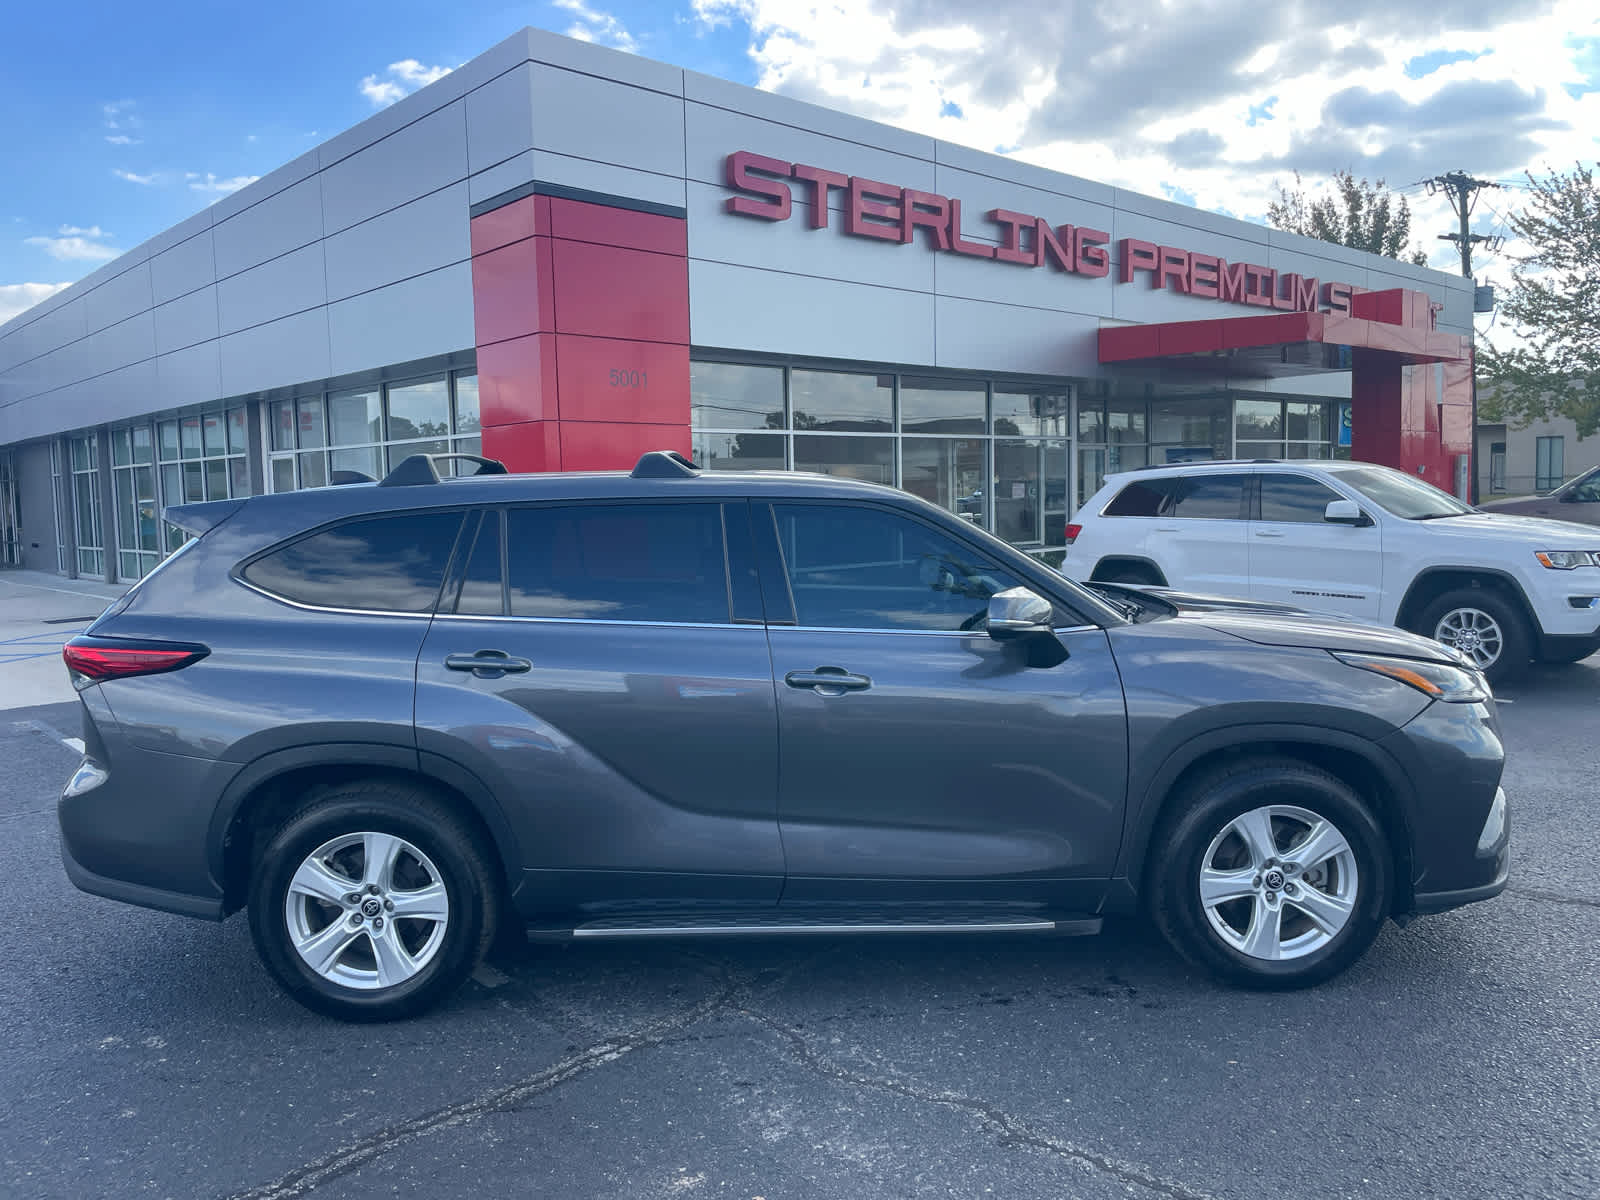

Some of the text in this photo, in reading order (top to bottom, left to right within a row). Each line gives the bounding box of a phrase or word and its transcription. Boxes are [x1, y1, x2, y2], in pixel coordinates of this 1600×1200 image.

[727, 150, 1109, 277] STERLING
[1119, 238, 1319, 313] PREMIUM
[609, 368, 648, 390] 5001
